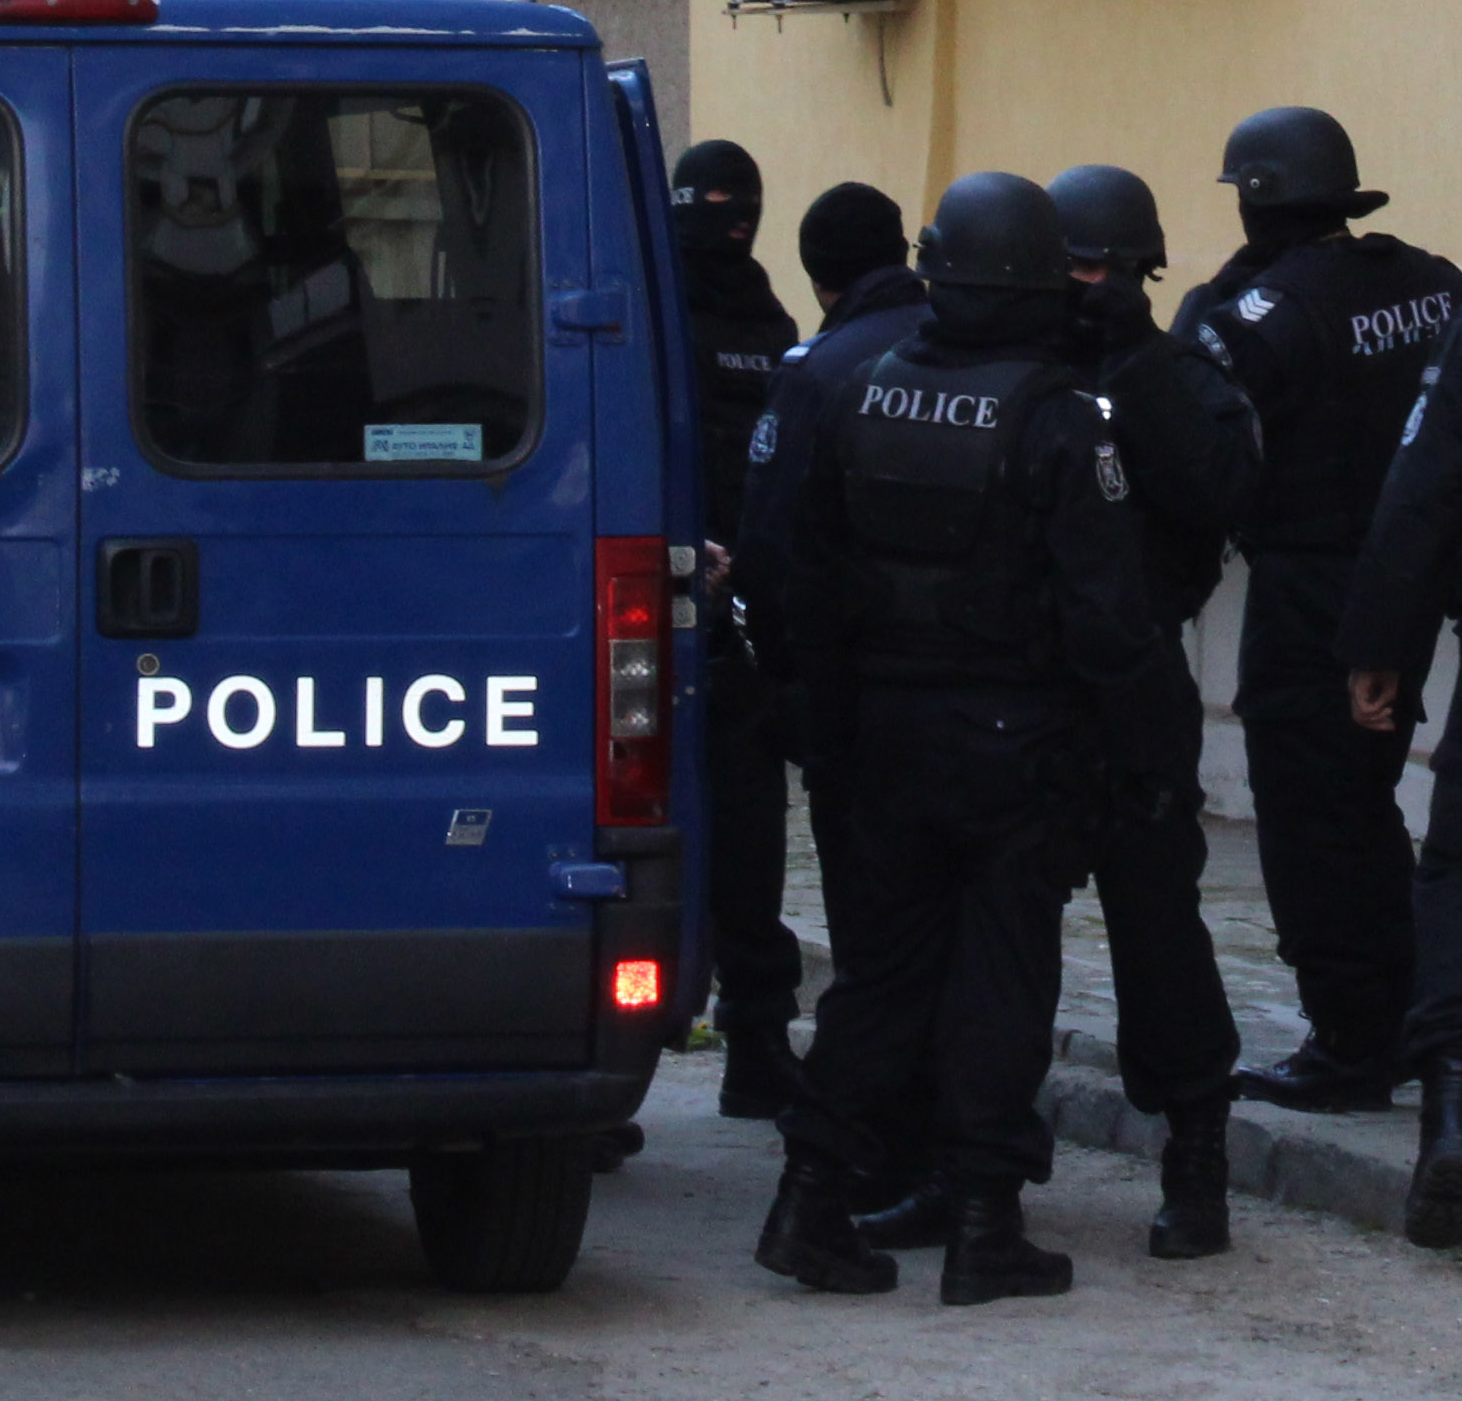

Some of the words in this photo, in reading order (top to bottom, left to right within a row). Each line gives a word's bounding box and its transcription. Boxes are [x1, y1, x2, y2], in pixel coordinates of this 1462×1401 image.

[716, 352, 772, 371] POLICE
[858, 384, 999, 429] POLICE
[137, 674, 538, 749] POLICE
